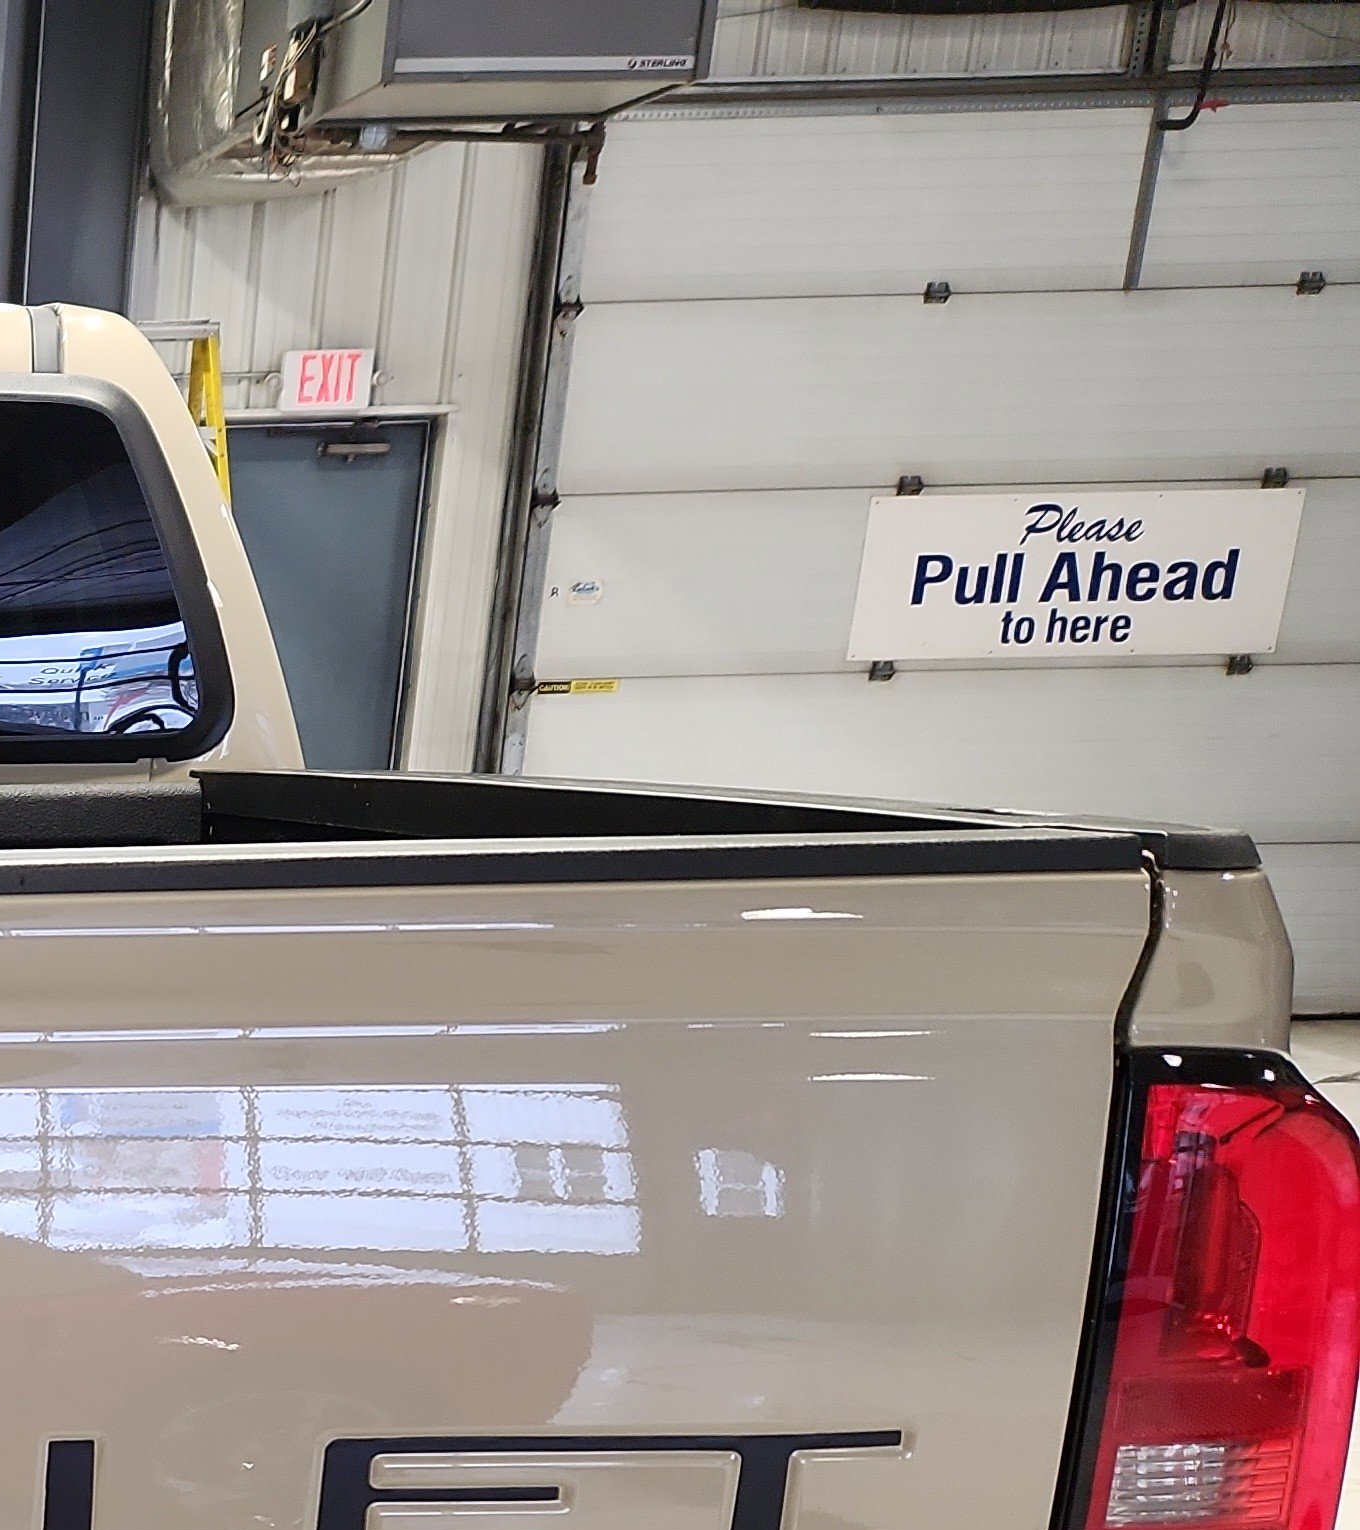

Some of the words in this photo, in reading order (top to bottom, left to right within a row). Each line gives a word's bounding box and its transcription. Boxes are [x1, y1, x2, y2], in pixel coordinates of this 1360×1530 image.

[297, 352, 363, 403] EXIT
[1019, 503, 1145, 545] Please
[910, 552, 1025, 606] Pull
[1038, 548, 1241, 603] Ahead
[1000, 609, 1034, 644] to
[1045, 607, 1132, 643] here
